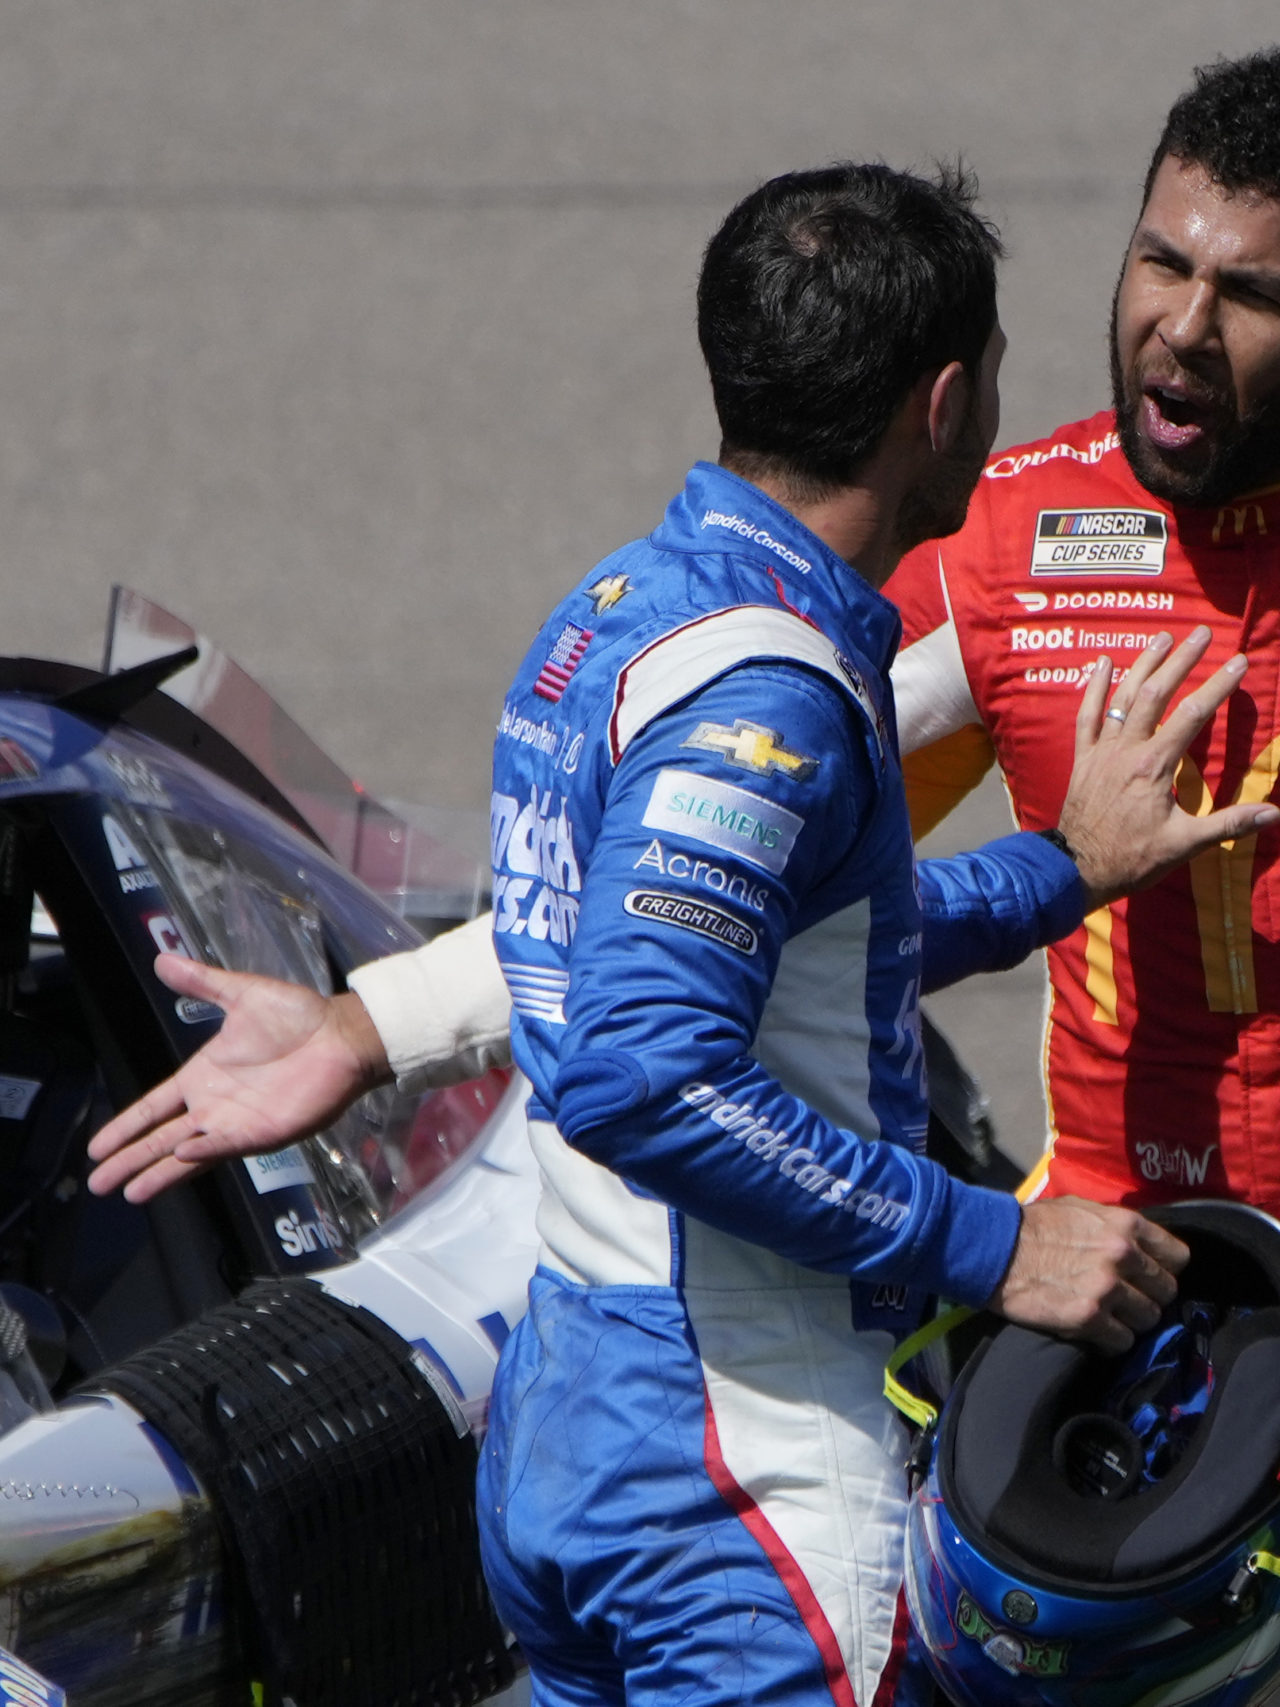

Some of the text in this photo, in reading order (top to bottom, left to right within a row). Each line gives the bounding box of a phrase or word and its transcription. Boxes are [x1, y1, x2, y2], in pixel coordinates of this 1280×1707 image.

[1077, 514, 1146, 536] NASCAR
[1051, 544, 1146, 562] CUP SERIES
[1053, 592, 1174, 610] DOORDASH
[1011, 626, 1156, 650] Root Insuran
[666, 792, 782, 848] SIEMENS
[633, 838, 769, 912] Acronis
[638, 897, 751, 946] FREIGHTLINER
[679, 1082, 911, 1231] endrickCars.com
